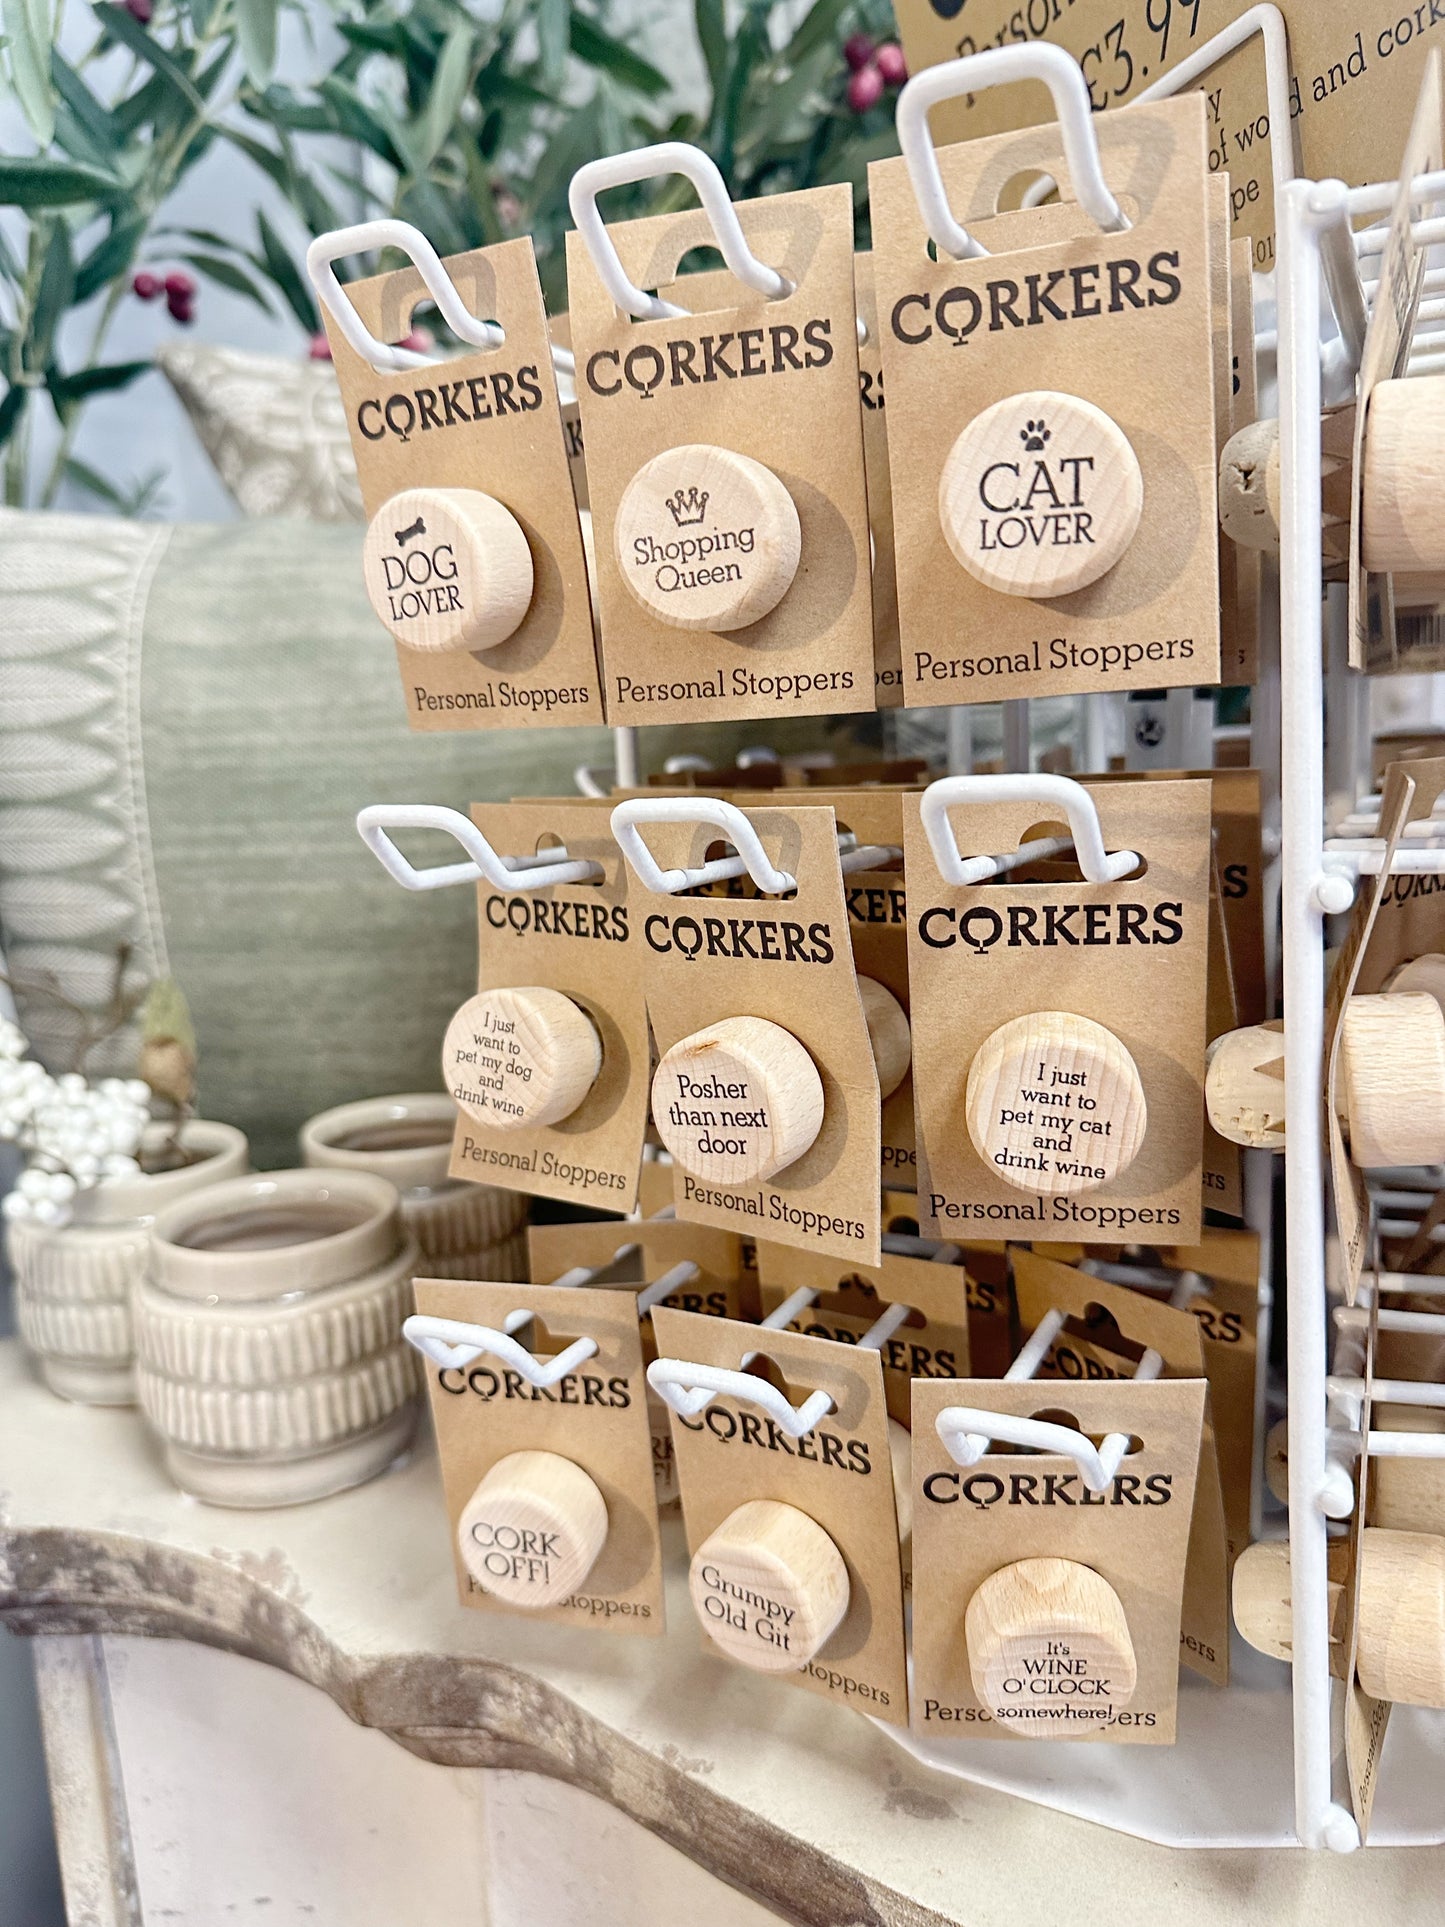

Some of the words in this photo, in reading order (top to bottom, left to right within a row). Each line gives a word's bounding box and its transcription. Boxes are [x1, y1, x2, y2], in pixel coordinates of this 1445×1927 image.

[1208, 129, 1229, 171] of
[1234, 77, 1304, 151] wod
[1312, 33, 1368, 102] and
[891, 251, 1182, 346] CORKERS
[586, 319, 834, 399] CORKERS
[357, 366, 543, 442] CORKERS
[978, 457, 1094, 511] CAT
[634, 526, 755, 566] Shopping
[979, 512, 1096, 550] LOVER
[382, 545, 459, 590] DOG
[655, 564, 742, 592] Queen
[389, 585, 464, 621] LOVER
[915, 642, 1041, 681] Personal
[1049, 637, 1194, 672] Stoppers
[414, 683, 495, 711] Personal
[499, 682, 589, 708] Stoppers
[616, 672, 726, 703] Personal
[732, 668, 854, 698] Stoppers
[486, 895, 630, 942] CORKERS
[918, 902, 1183, 954] CORKERS
[645, 914, 834, 964] CORKERS
[484, 1011, 492, 1028] I
[492, 1015, 515, 1036] just
[473, 1034, 506, 1051] want
[509, 1044, 521, 1055] to
[456, 1047, 479, 1066] pet
[481, 1056, 503, 1074] my
[505, 1060, 532, 1081] dog
[1037, 1063, 1045, 1081] I
[1050, 1067, 1087, 1087] just
[478, 1073, 504, 1091] and
[677, 1074, 748, 1099] Posher
[1021, 1088, 1071, 1107] want
[1078, 1094, 1096, 1110] to
[453, 1083, 490, 1107] drink
[492, 1099, 525, 1117] wine
[669, 1103, 717, 1128] than
[721, 1108, 768, 1128] next
[1000, 1108, 1034, 1126] pet
[1041, 1116, 1072, 1134] my
[1079, 1117, 1112, 1136] cat
[698, 1131, 747, 1155] door
[1033, 1133, 1072, 1153] and
[461, 1137, 538, 1173] Personal
[541, 1151, 627, 1191] Stoppers
[994, 1150, 1050, 1172] drink
[1055, 1161, 1107, 1180] wine
[683, 1176, 766, 1218] Personal
[769, 1195, 865, 1240] Stoppers
[929, 1194, 1045, 1221] Personal
[1052, 1197, 1181, 1228] Stoppers
[922, 1472, 1173, 1510] CORKRS
[471, 1522, 562, 1559] CORK
[484, 1551, 551, 1585] OFF!
[701, 1566, 796, 1625] Grumpy
[704, 1599, 748, 1633] Old
[755, 1619, 792, 1652] Git
[1046, 1641, 1071, 1656] It's
[1023, 1659, 1088, 1676] WINE
[1003, 1678, 1111, 1696] O'CLOCK
[923, 1700, 992, 1722] Perso
[996, 1704, 1114, 1721] somewhere!
